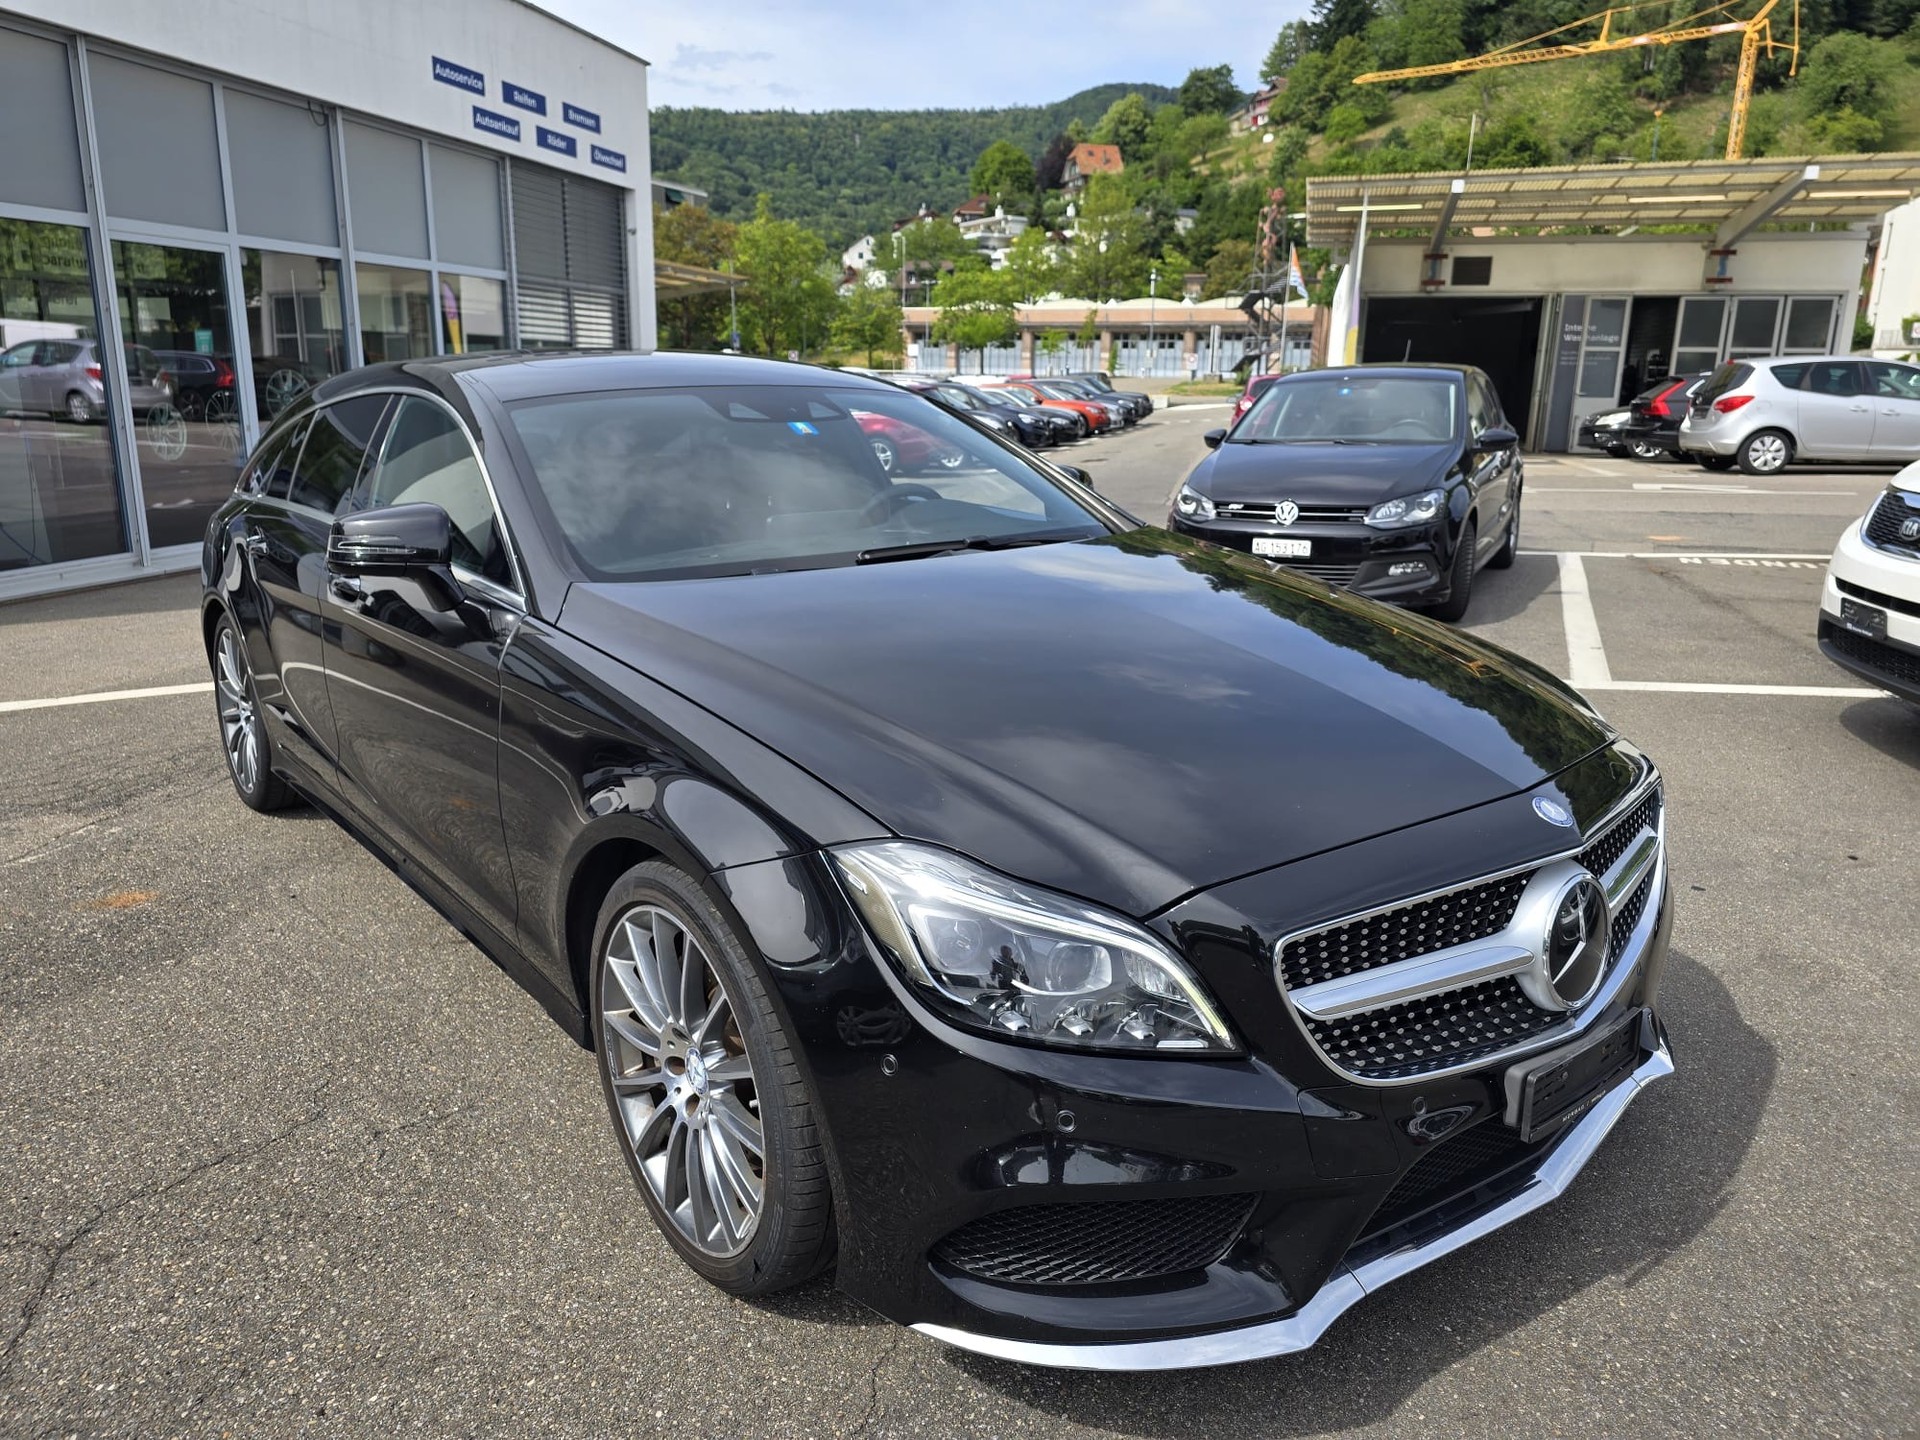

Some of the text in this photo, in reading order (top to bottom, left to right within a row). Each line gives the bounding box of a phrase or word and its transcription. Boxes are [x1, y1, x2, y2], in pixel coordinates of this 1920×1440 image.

[434, 63, 483, 90] Autoservice
[475, 113, 519, 137] Autoankauf
[1564, 323, 1597, 332] Intene
[1902, 520, 1919, 536] KIA
[1679, 556, 1829, 569] UNDEN
